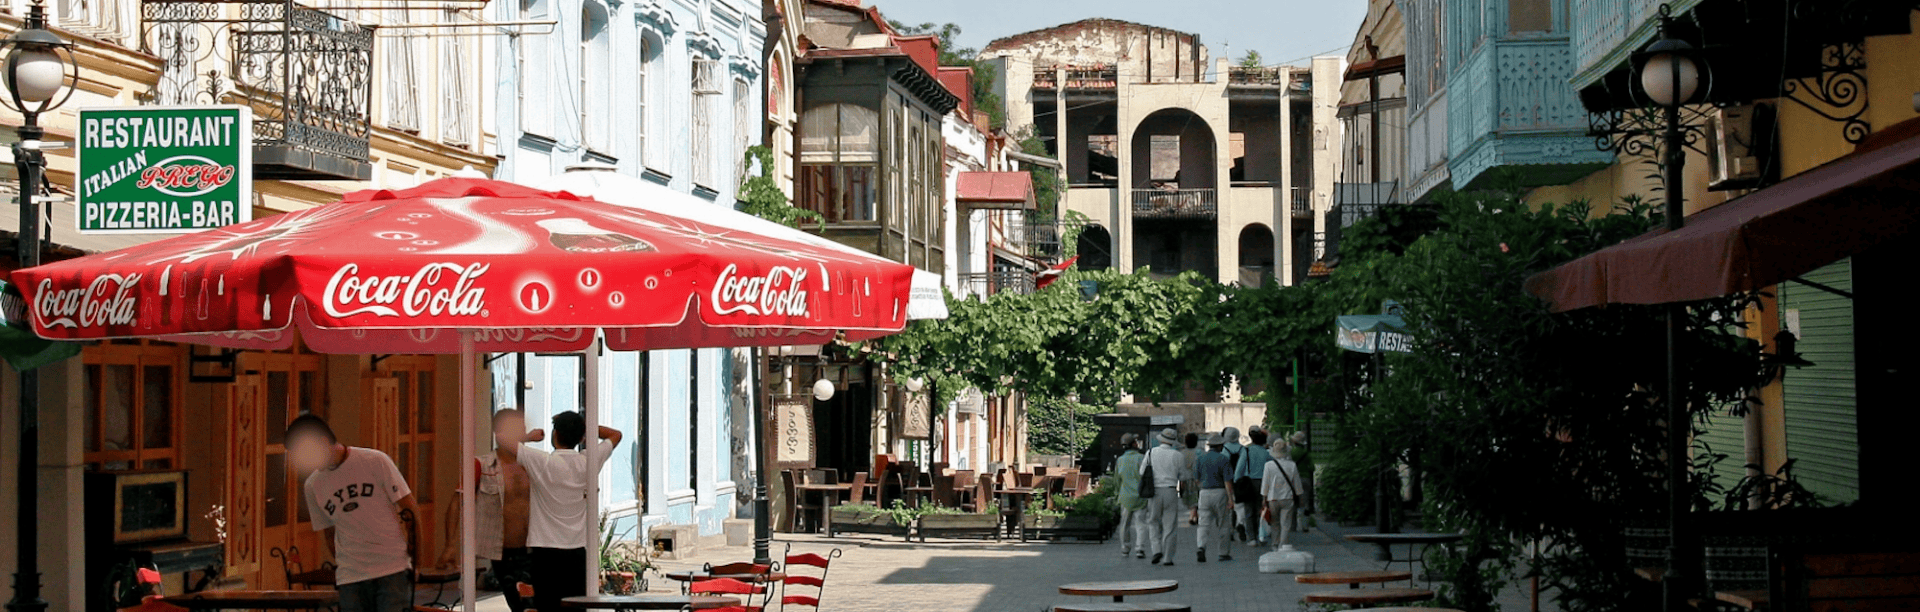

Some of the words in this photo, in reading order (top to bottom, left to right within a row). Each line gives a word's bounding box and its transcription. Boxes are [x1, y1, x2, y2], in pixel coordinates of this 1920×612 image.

[85, 116, 235, 148] RESTAURANT
[83, 149, 148, 198] ITALIAN
[136, 164, 235, 189] PREGO
[85, 201, 234, 229] PIZZERIA-BAR
[33, 272, 143, 328] Coca-Cola
[322, 262, 491, 318] Coca-Cola
[711, 263, 807, 316] Coca-Cola
